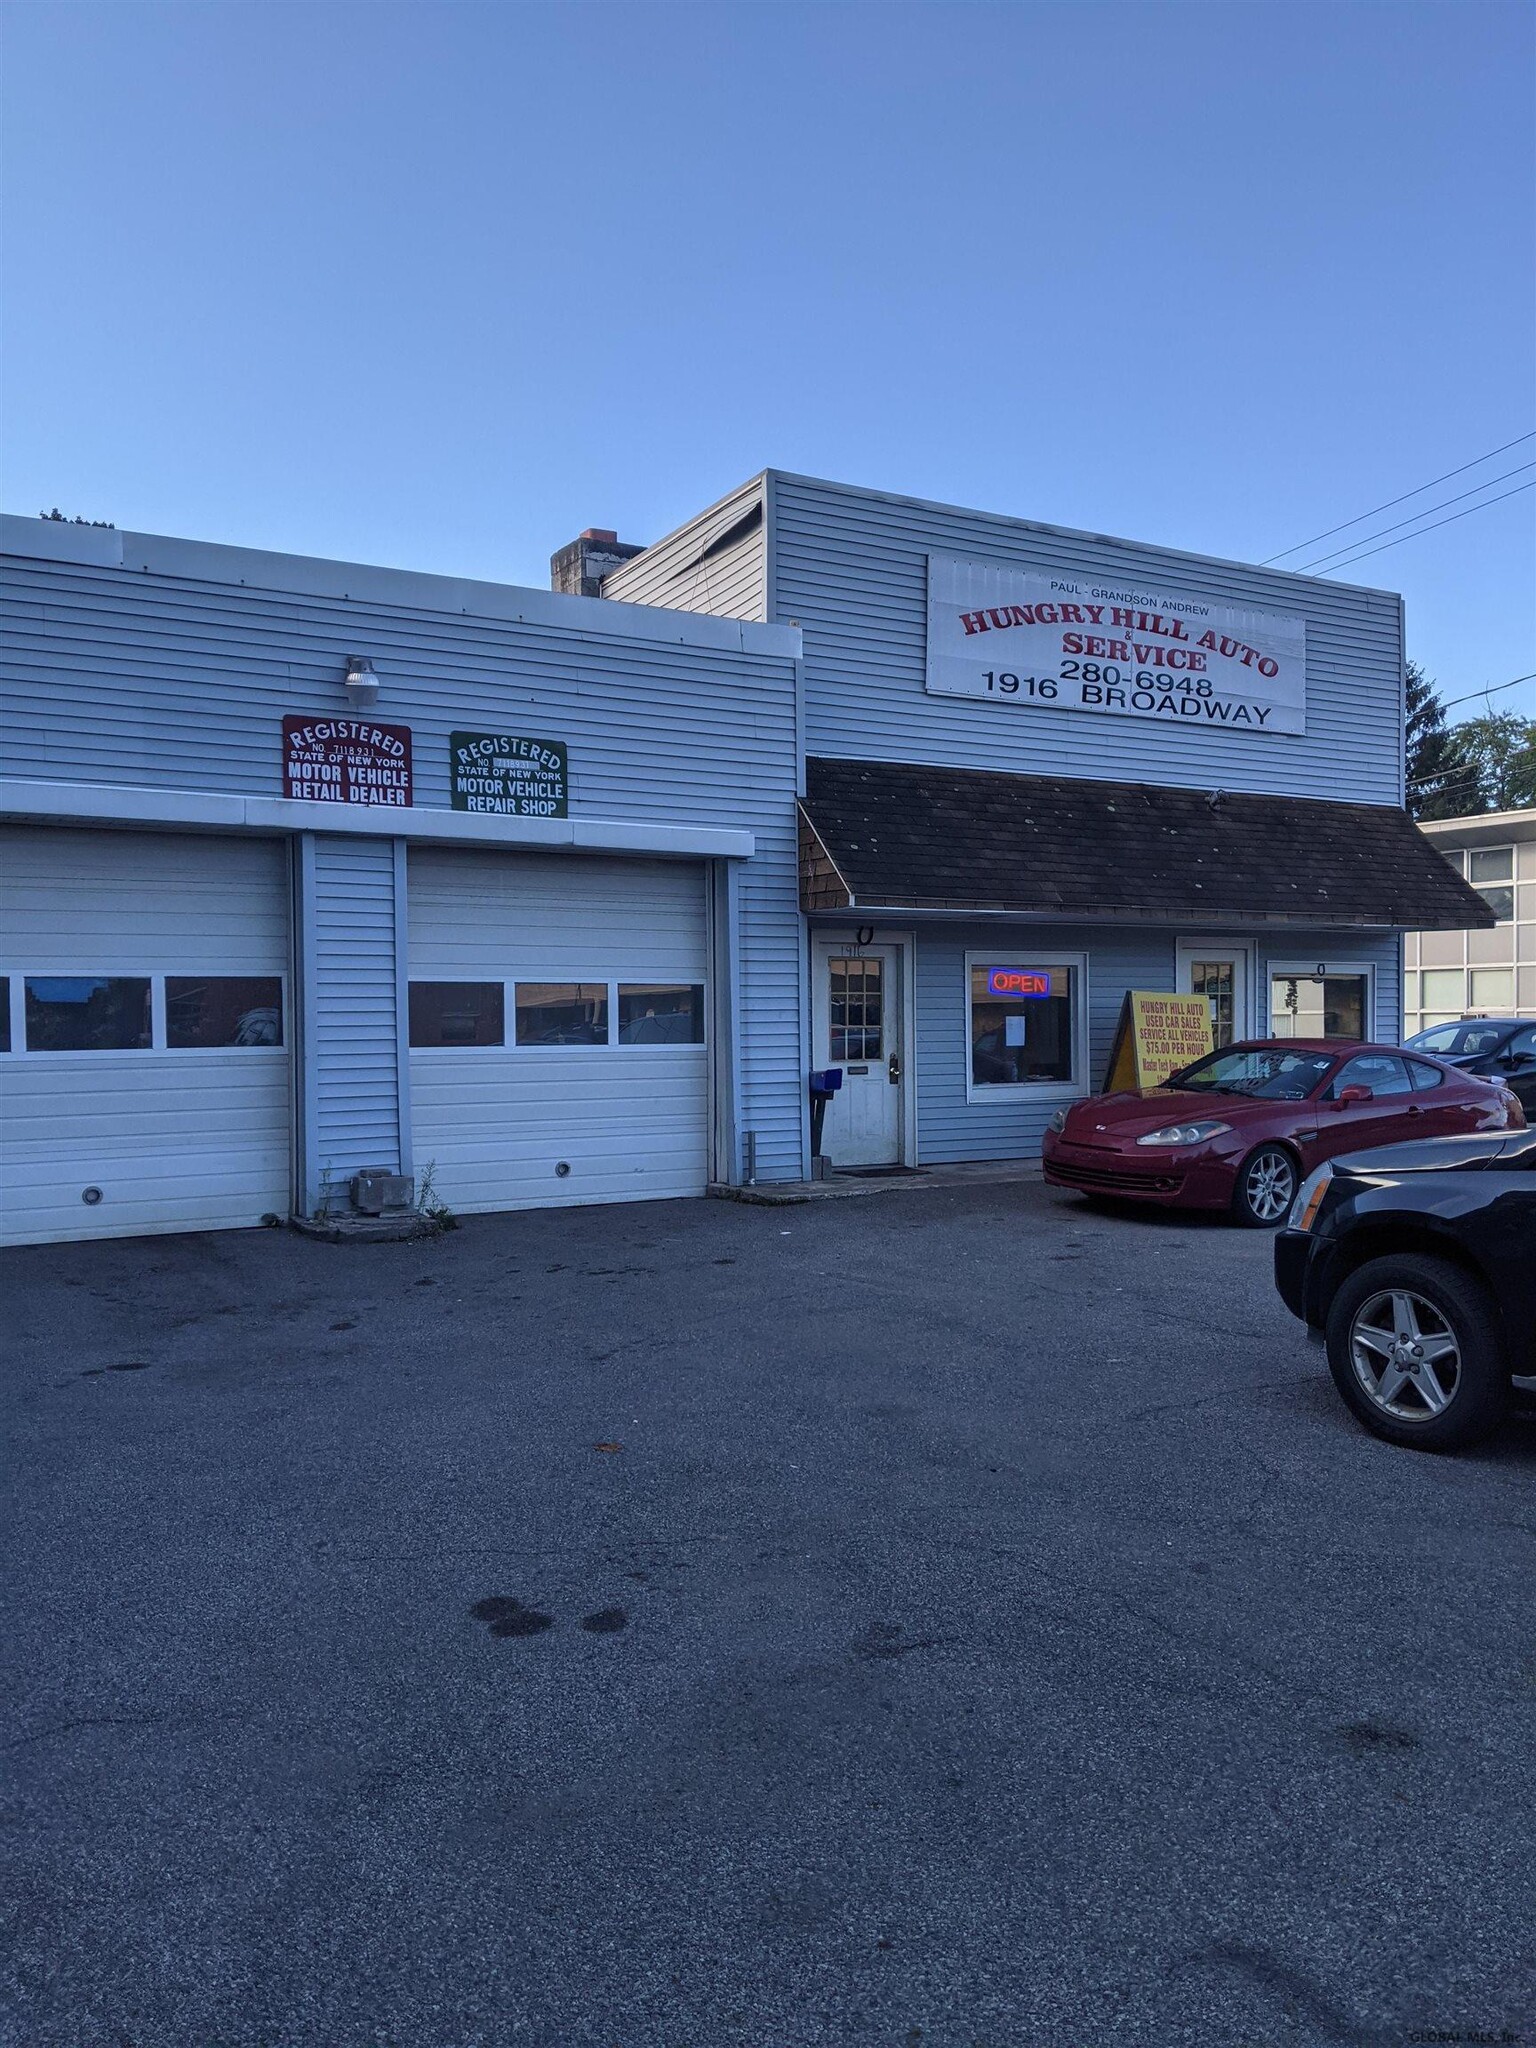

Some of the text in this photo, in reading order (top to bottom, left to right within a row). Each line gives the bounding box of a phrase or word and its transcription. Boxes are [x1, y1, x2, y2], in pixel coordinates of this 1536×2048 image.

[1050, 580, 1082, 595] PAUL
[1091, 588, 1158, 608] GRANDSON
[1161, 600, 1210, 617] ANDREW
[958, 602, 1280, 679] HUNGRY HILL AUTO
[1125, 630, 1133, 641] &
[1062, 632, 1207, 673] SERVICE
[1059, 659, 1213, 698] 280-6948
[981, 670, 1272, 726] 1916 BROADWAY
[290, 721, 405, 757] REGISTERED
[290, 750, 405, 769] STATE OF NEW YORK
[333, 745, 375, 757] 7118931
[457, 737, 561, 770] REGISTERED
[288, 761, 409, 787] MOTOR VEHICLE
[458, 765, 562, 781] STATE OF NEW YORK
[291, 781, 406, 805] RETAIL DEALER
[457, 777, 564, 799] MOTOR VEHICLE
[467, 795, 557, 816] REPAIR SHOP
[993, 972, 1046, 992] OPEN
[1140, 1000, 1204, 1016] HUNGRY HILL AUTO
[1145, 1015, 1201, 1029] USED CAR SALES
[1140, 1028, 1209, 1043] SERVICE ALL VEHICLES
[1146, 1042, 1206, 1056] $75.00 PER HOUR
